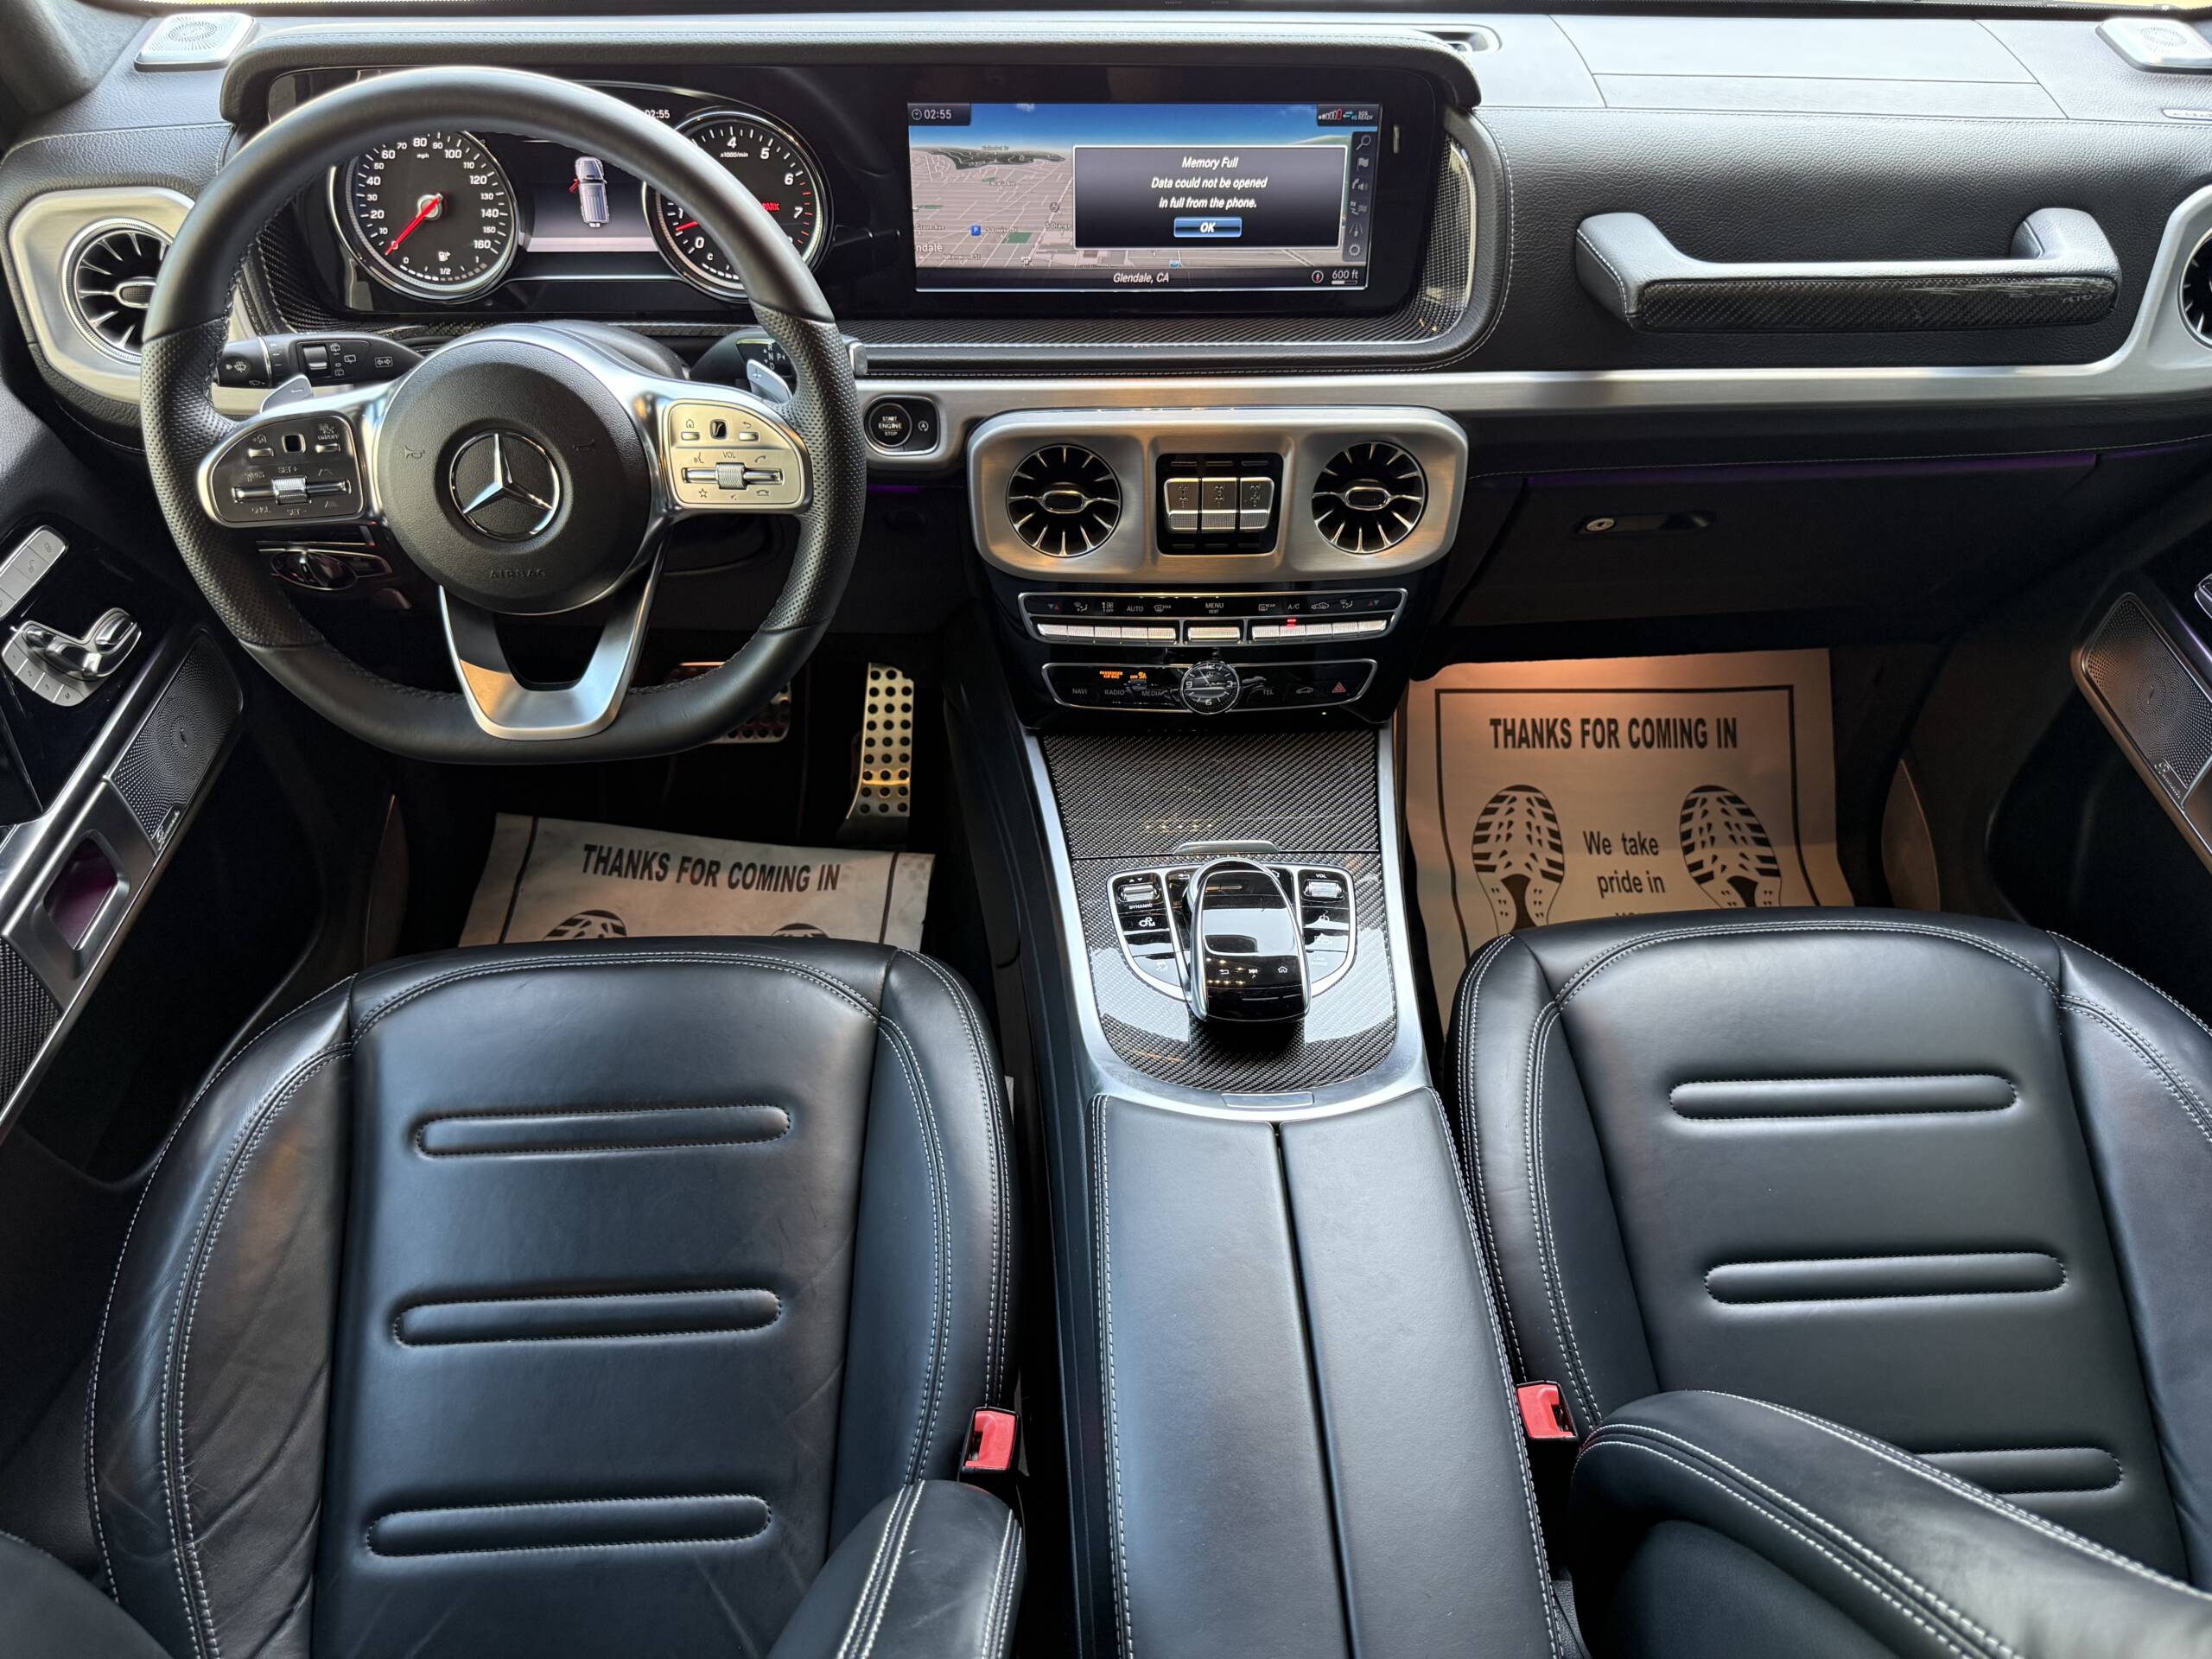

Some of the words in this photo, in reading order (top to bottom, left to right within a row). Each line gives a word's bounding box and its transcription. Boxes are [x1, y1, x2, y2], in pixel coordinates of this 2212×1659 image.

[925, 109, 951, 119] 02:55
[413, 137, 428, 147] 80
[727, 137, 737, 148] 4
[382, 150, 396, 159] 60
[444, 149, 462, 159] 100
[760, 147, 770, 159] 5
[1182, 156, 1219, 170] Memory
[1221, 156, 1239, 168] Full
[366, 176, 381, 186] 40
[470, 175, 487, 185] 120
[785, 173, 794, 186] 6
[1151, 177, 1173, 188] Data
[1175, 177, 1201, 188] could
[1202, 178, 1218, 188] not
[1219, 177, 1231, 188] be
[1233, 176, 1268, 190] opened
[1170, 197, 1185, 208] full
[1186, 197, 1208, 208] from
[1210, 197, 1224, 208] the
[1226, 197, 1257, 210] phone.
[370, 210, 385, 219] 20
[481, 209, 499, 218] 140
[678, 207, 683, 219] 1
[793, 207, 804, 219] 7
[1200, 222, 1216, 233] OK
[474, 239, 492, 249] 160
[695, 237, 705, 249] 0
[707, 252, 714, 261] C
[1113, 272, 1154, 284] Glendale,
[1156, 272, 1169, 283] CA
[1332, 270, 1350, 279] 600
[1351, 270, 1358, 279] ft
[776, 353, 782, 361] P
[1490, 718, 1572, 749] THANKS
[1580, 718, 1620, 749] FOR
[1628, 718, 1707, 749] COMING
[1717, 717, 1738, 749] IN
[1583, 830, 1612, 855] We
[1621, 830, 1659, 855] take
[582, 843, 671, 882] THANKS
[676, 855, 721, 887] FOR
[728, 861, 810, 893] COMING
[817, 864, 842, 892] IN
[1597, 869, 1643, 899] pride
[1646, 869, 1666, 893] in
